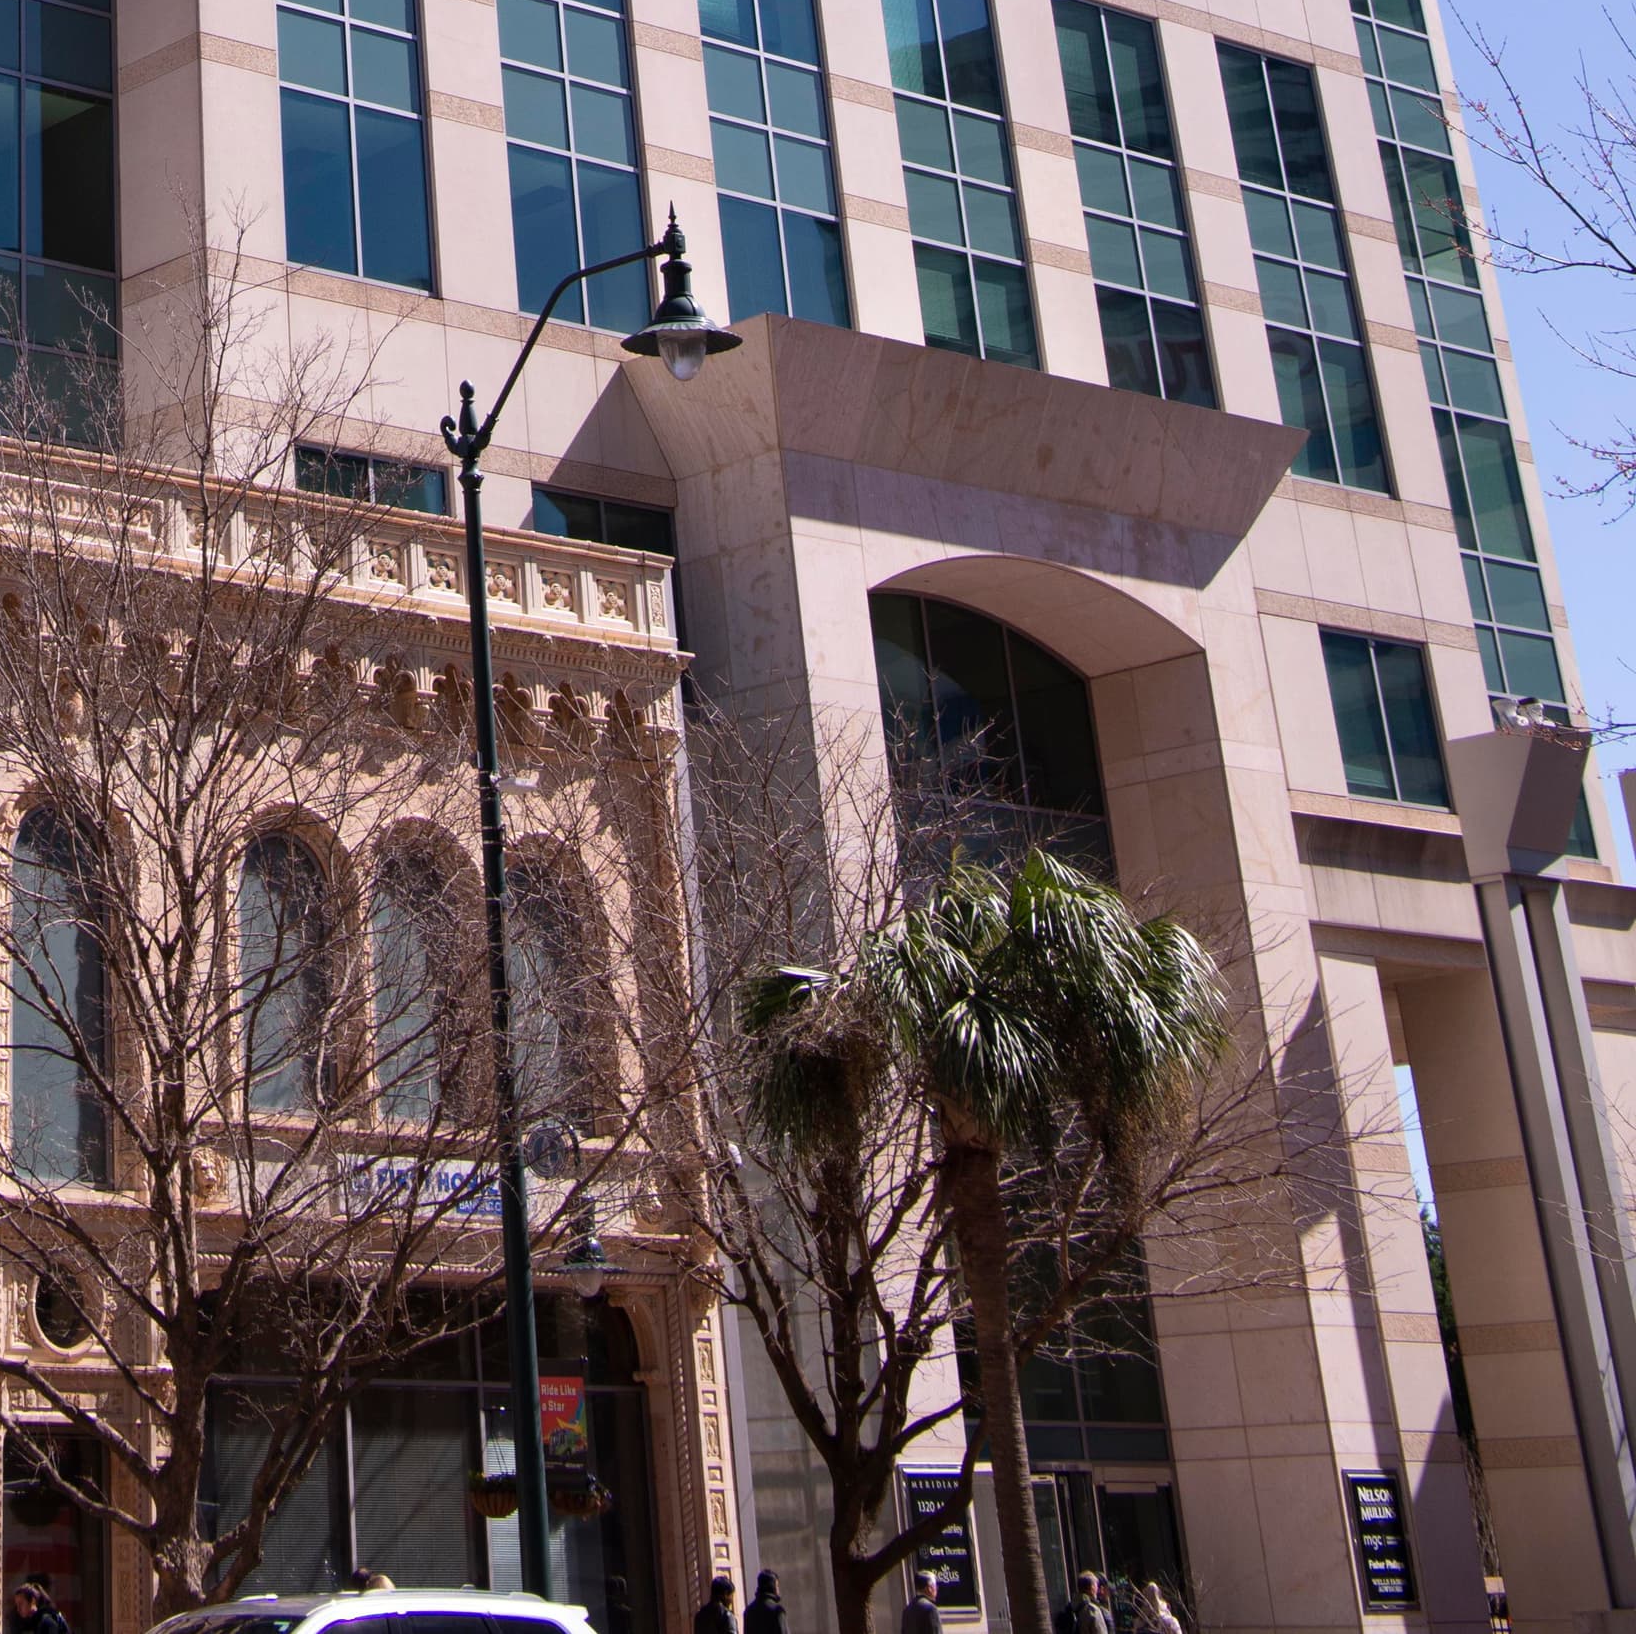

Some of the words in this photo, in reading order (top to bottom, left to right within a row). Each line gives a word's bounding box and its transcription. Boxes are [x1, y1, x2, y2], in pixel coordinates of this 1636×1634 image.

[541, 1384, 559, 1396] Ride
[559, 1384, 577, 1396] Like
[548, 1400, 565, 1412] Star
[911, 1480, 959, 1489] MERIDIAN
[917, 1500, 935, 1513] 1320
